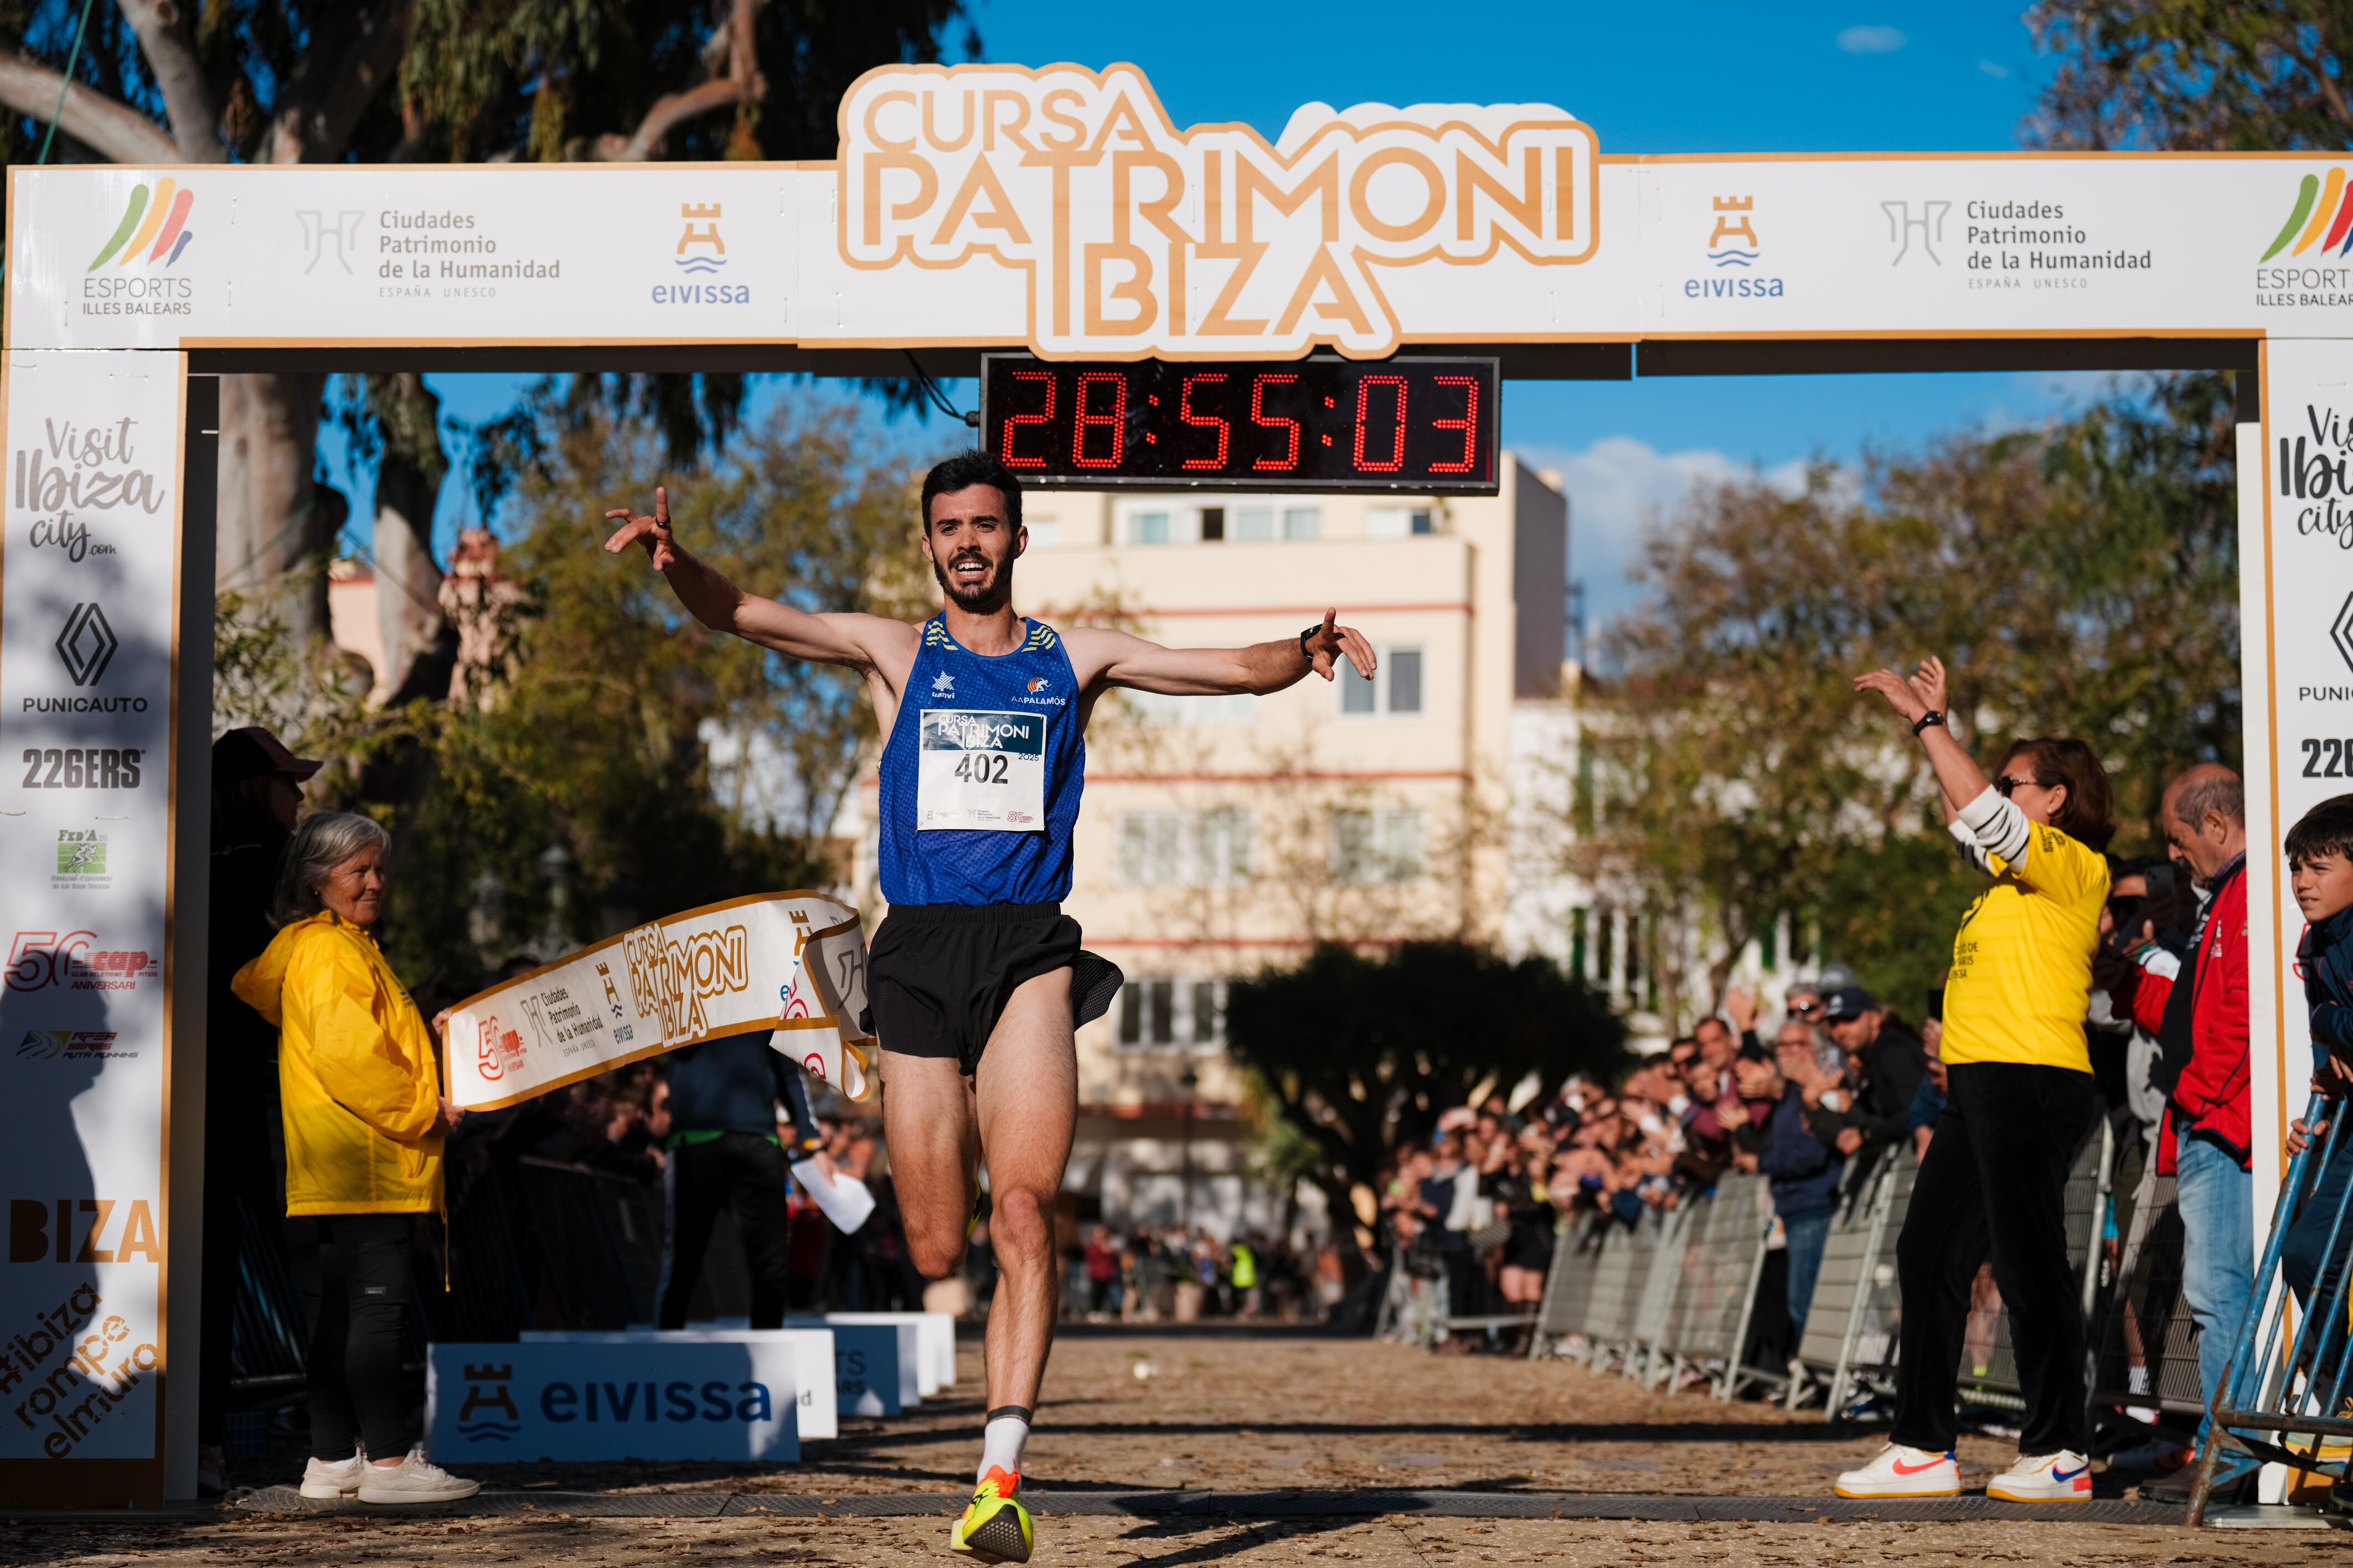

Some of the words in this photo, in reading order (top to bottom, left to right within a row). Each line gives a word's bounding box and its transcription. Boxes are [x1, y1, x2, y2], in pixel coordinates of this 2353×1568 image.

[863, 88, 1157, 153] CURSA
[863, 146, 1574, 246] PATRIMONI
[379, 210, 476, 229] Ciudades
[1967, 200, 2064, 220] Ciudades
[379, 235, 497, 253] Patrimonio
[1967, 226, 2087, 244] Patrimonio
[379, 259, 404, 279] de
[411, 259, 431, 279] la
[441, 259, 560, 279] Humanidad
[1967, 251, 1992, 270] de
[2001, 250, 2019, 270] la
[2030, 250, 2152, 270] Humanidad
[84, 278, 192, 298] ESPORTS
[1969, 275, 2022, 289] ESPAÑA
[2034, 278, 2087, 289] UNESCO
[2257, 269, 2353, 289] ESPORT
[379, 284, 431, 298] ESPAÑA
[443, 287, 496, 298] UNESCO
[2256, 294, 2295, 306] ILLES
[82, 302, 121, 315] ILLES
[125, 302, 192, 315] BALEARS
[1002, 371, 1479, 473] 28:55:03
[45, 417, 138, 467] Visit
[16, 449, 166, 515] Ibiza
[2299, 687, 2353, 701] PUNI
[23, 697, 148, 713] PUNICAUTO
[938, 715, 978, 725] CURSA
[938, 722, 1030, 739] PATRIMONI
[1018, 753, 1040, 762] 2025
[22, 748, 142, 789] 226ERS
[954, 753, 1009, 784] 402
[626, 932, 665, 965] CURSA
[631, 936, 743, 1006] PATRIMONI
[71, 981, 136, 990] ANIVERSARI
[540, 987, 569, 1007] Ciudades
[548, 1001, 581, 1026] Patrimonio
[72, 1032, 118, 1043] RFEA
[556, 1028, 566, 1043] de
[563, 1026, 574, 1041] la
[571, 1013, 603, 1037] Humanidad
[62, 1052, 91, 1060] RUTA
[66, 1043, 113, 1051] SERIES
[13, 1315, 131, 1430] rompe
